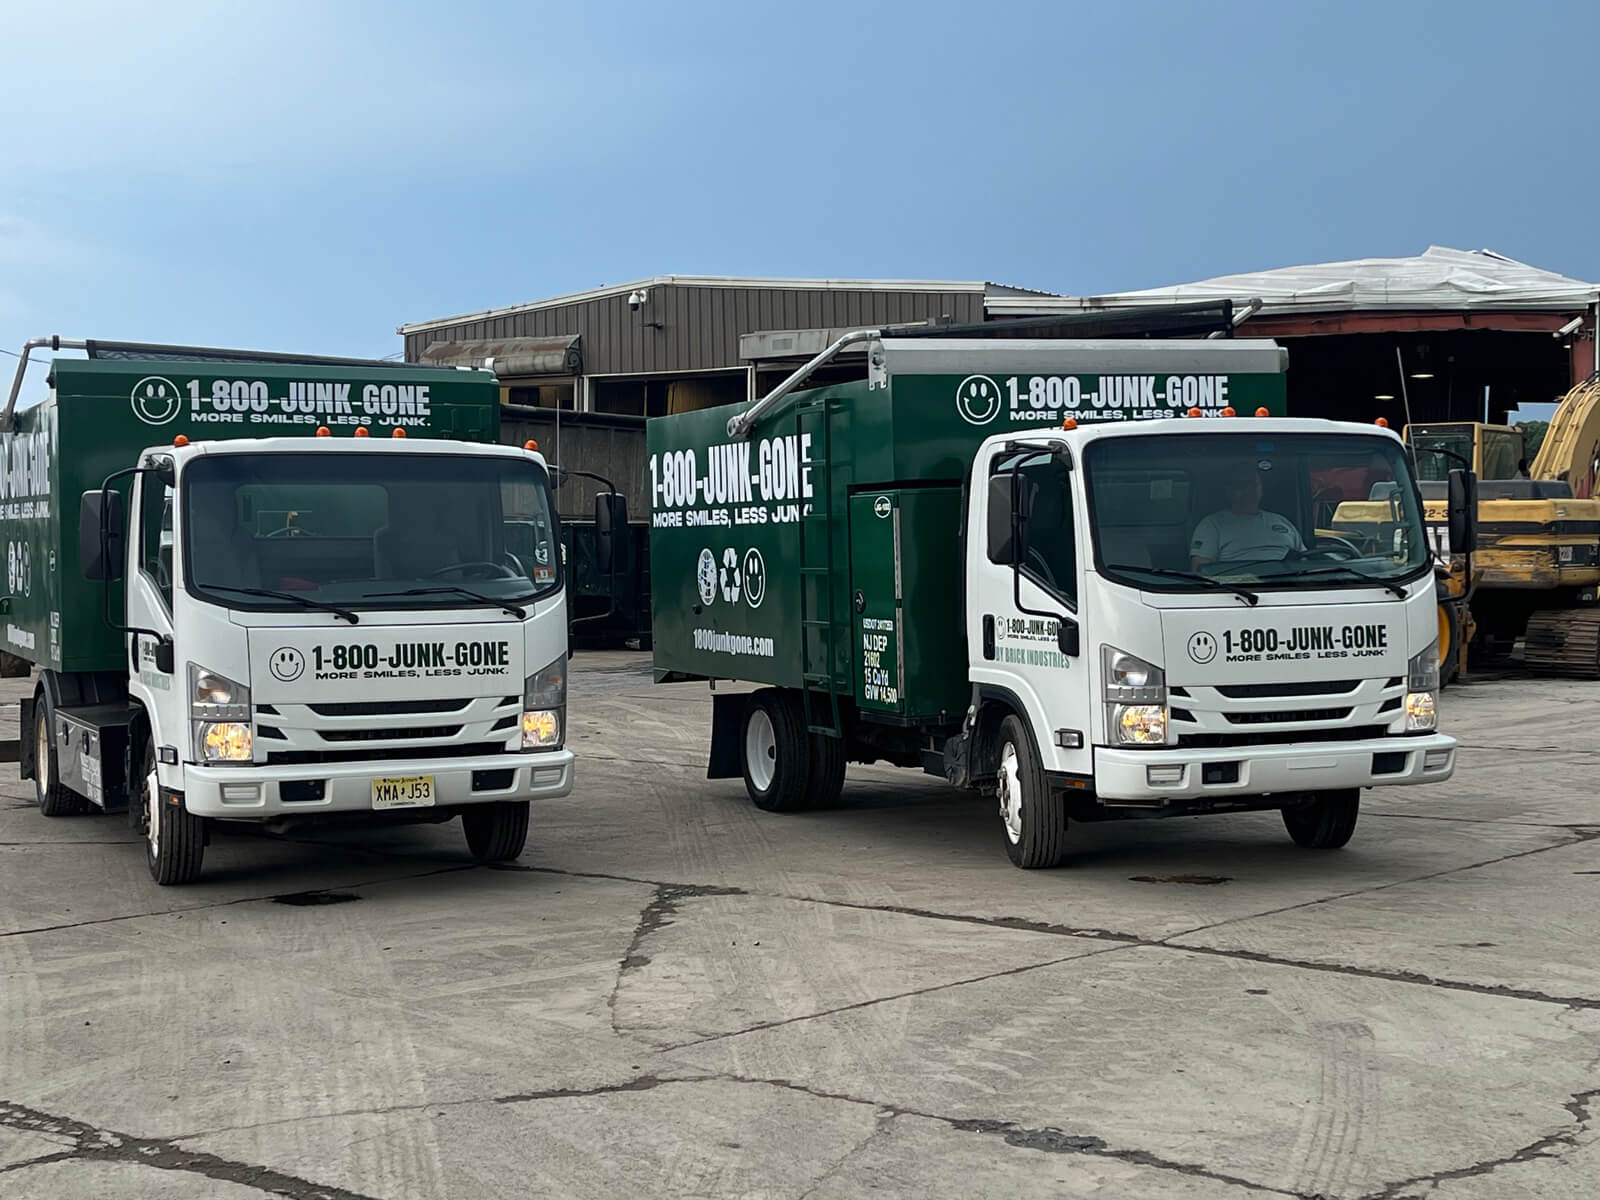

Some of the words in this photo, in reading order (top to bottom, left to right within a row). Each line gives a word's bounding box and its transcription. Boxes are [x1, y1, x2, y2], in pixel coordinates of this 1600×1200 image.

[186, 379, 431, 416] 1-800-JUNK-GONE
[1006, 376, 1229, 409] 1-800-JUNK-GONE
[191, 412, 243, 422] MORE
[250, 414, 321, 425] SMILES,
[327, 416, 372, 425] LESS
[1010, 411, 1058, 420] MORE
[1063, 410, 1128, 420] SMILES,
[1133, 409, 1175, 419] LESS
[1180, 409, 1223, 418] JNK
[649, 433, 814, 509] 1-800-JUNK-GONE
[653, 511, 683, 528] MORE
[686, 508, 732, 528] SMILES,
[735, 506, 768, 525] LESS
[693, 628, 774, 657] 1800junkgone.com
[863, 633, 873, 651] NJ
[873, 635, 888, 652] DEP
[1223, 625, 1387, 654] 1-800-JUNK-GONE
[312, 641, 509, 671] 1-800-JUNK-GONE
[1005, 647, 1026, 664] BRICK
[1027, 649, 1071, 669] INDUSTRIES
[1226, 655, 1261, 663] MORE
[1317, 650, 1348, 659] LESS
[315, 671, 358, 680] MORE
[363, 670, 420, 679] SMILES,
[425, 669, 462, 677] LESS
[864, 667, 872, 684] 15
[865, 684, 879, 700] GVW
[376, 784, 399, 801] XMA
[407, 783, 431, 799] J53
